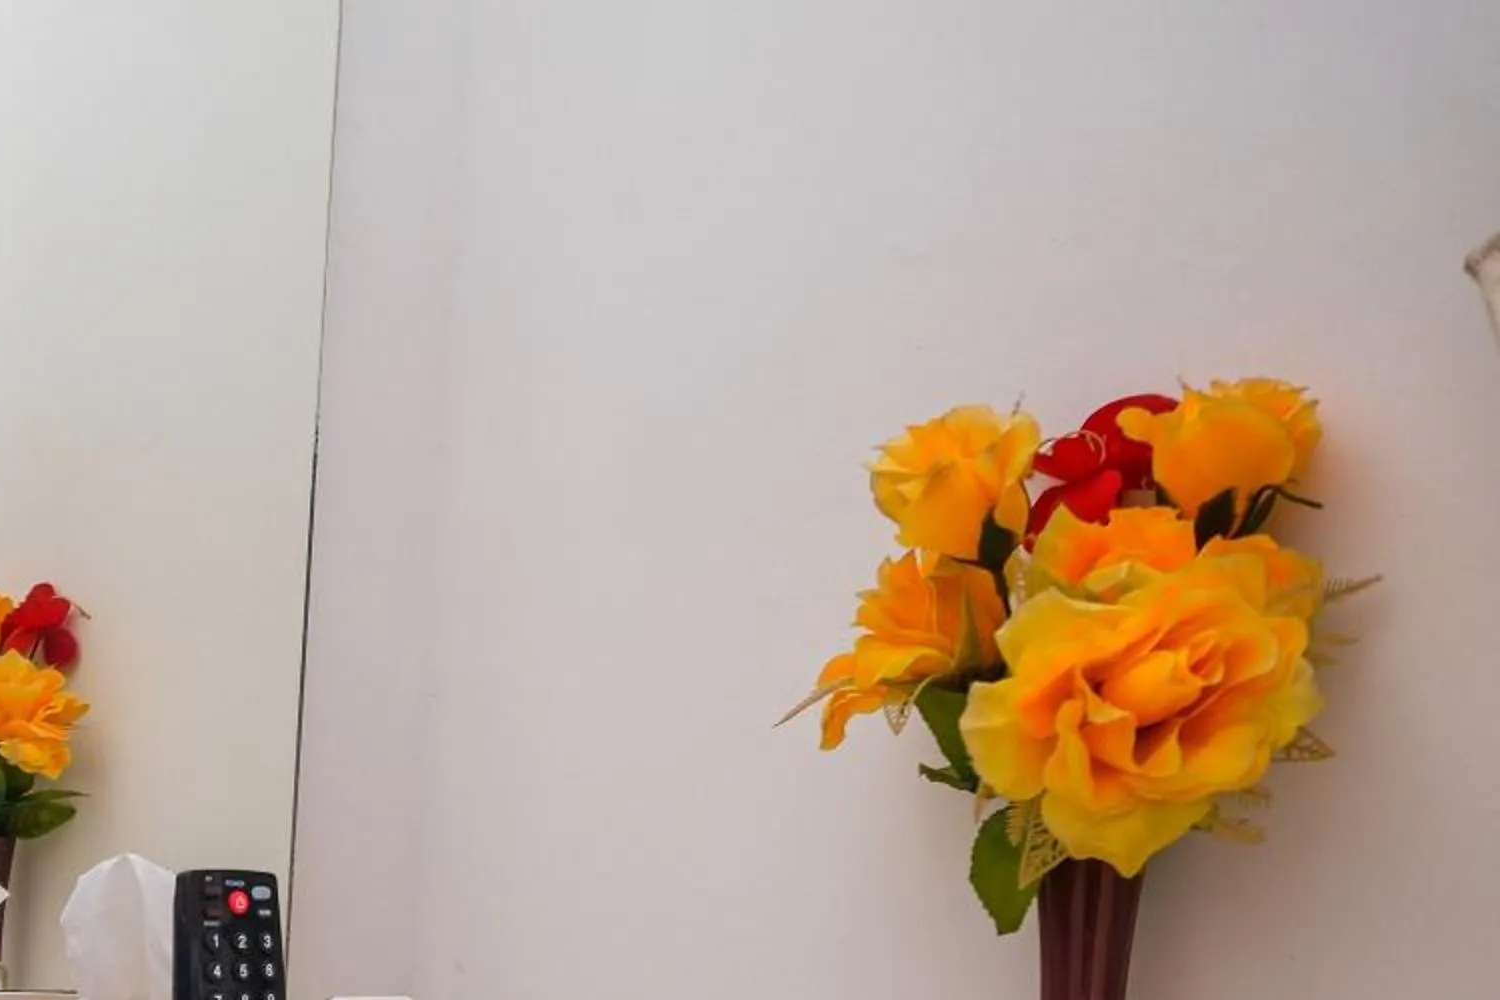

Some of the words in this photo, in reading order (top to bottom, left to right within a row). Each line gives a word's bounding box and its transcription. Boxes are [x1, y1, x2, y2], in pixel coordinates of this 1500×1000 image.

[212, 933, 220, 949] 1
[237, 933, 248, 949] 2
[262, 933, 273, 949] 3
[212, 964, 223, 979] 4
[238, 962, 249, 979] 5
[264, 962, 275, 978] 6
